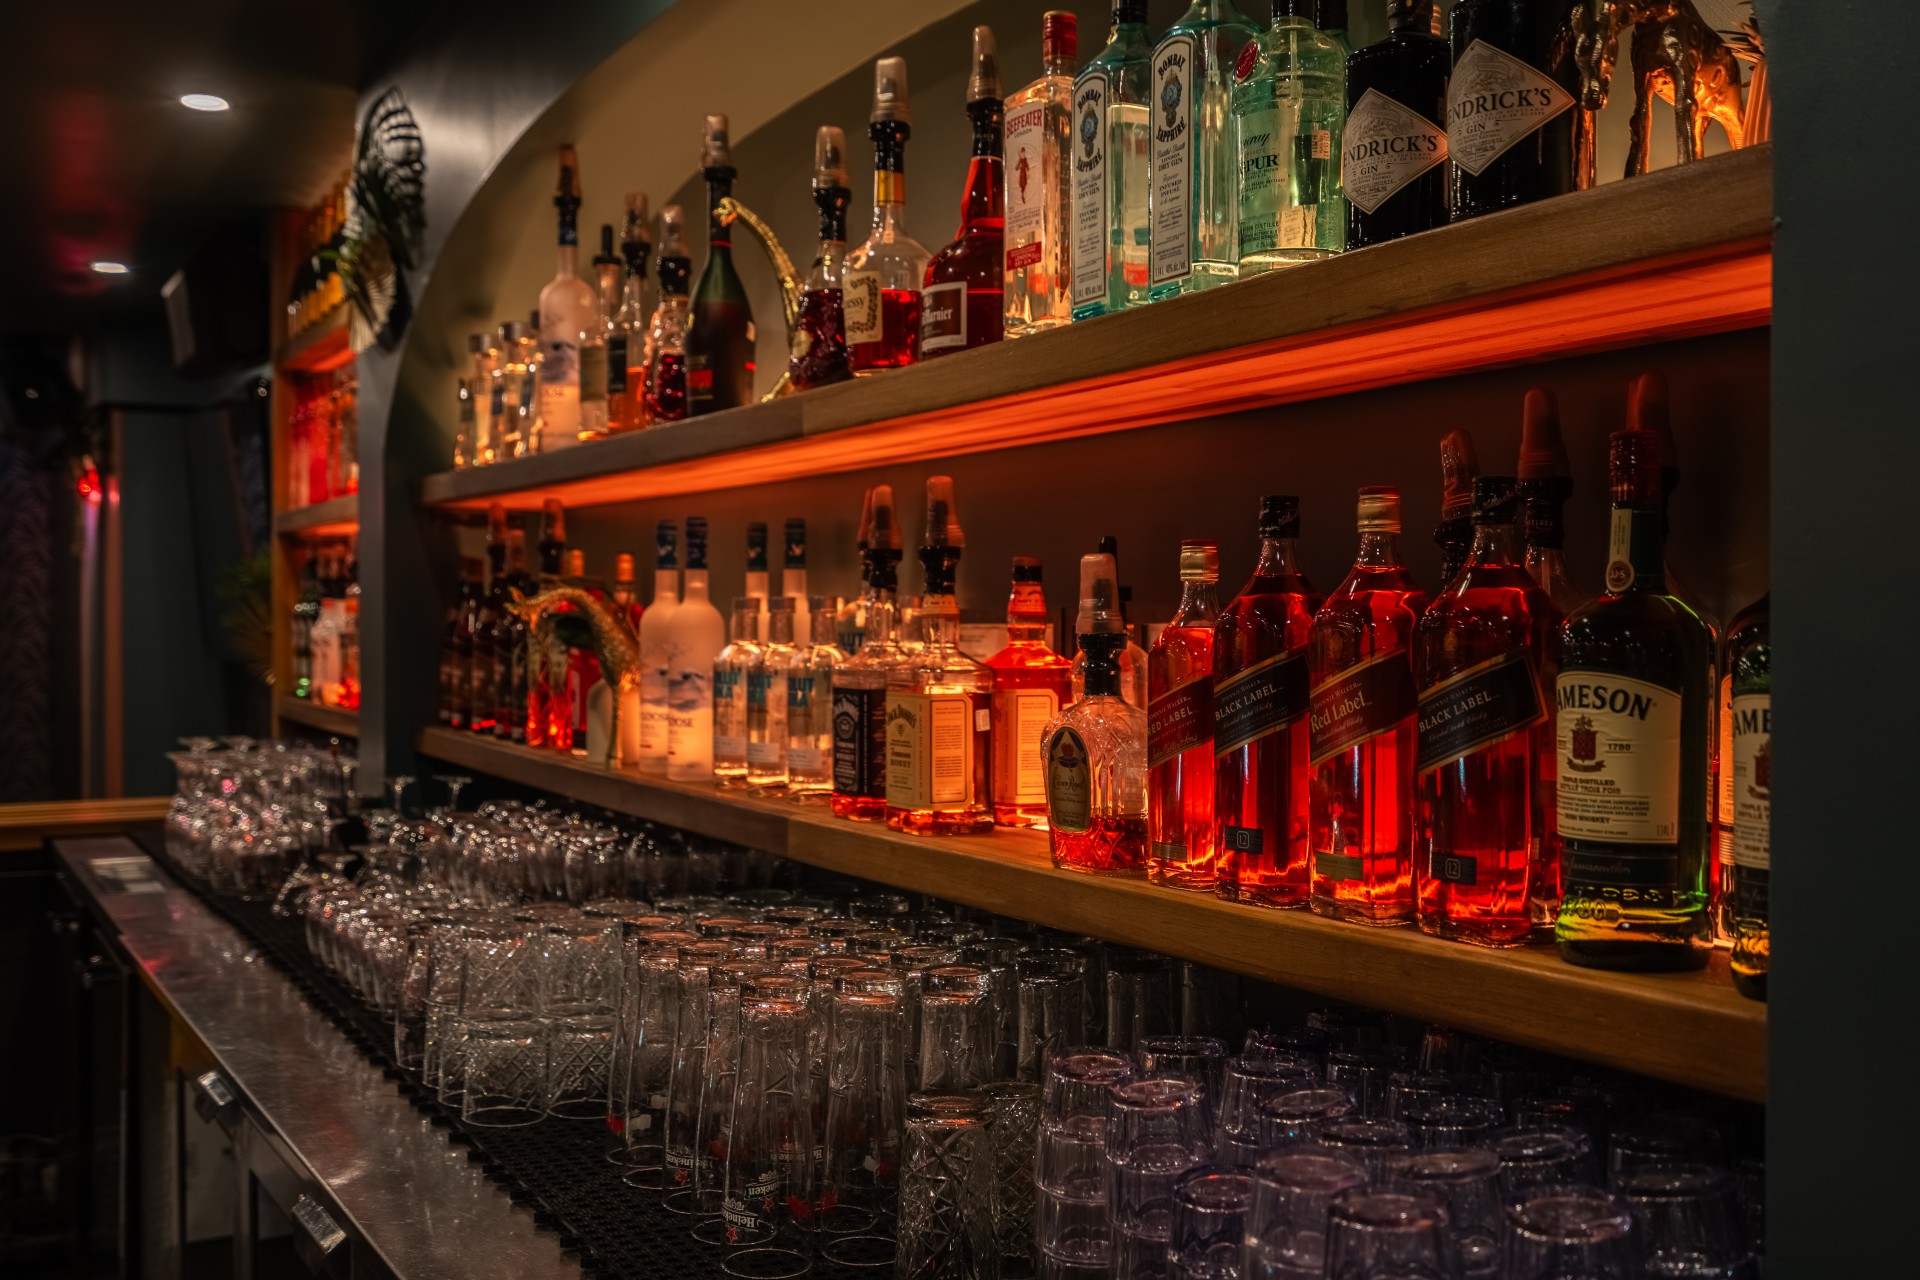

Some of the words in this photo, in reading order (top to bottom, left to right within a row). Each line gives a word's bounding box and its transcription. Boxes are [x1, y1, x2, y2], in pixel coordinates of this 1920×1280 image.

[1158, 53, 1186, 80] BOMBAY
[1077, 89, 1101, 114] BOMBAY
[1006, 108, 1043, 139] BEEFEATER
[1156, 115, 1187, 142] SAPPHIRE
[1466, 122, 1486, 134] GIN
[1076, 148, 1102, 172] SAPPHIRE
[1343, 134, 1438, 167] ENDRICK'S
[1158, 161, 1171, 172] DRY
[1171, 157, 1183, 167] GIN
[1244, 154, 1279, 173] PUR
[1360, 165, 1378, 176] GIN
[1215, 699, 1243, 721] BLACK
[1244, 684, 1277, 705] LABEL
[1310, 708, 1331, 733] Red
[1332, 690, 1367, 721] Label
[1419, 709, 1452, 733] BLACK
[1453, 691, 1492, 715] LABEL
[1558, 684, 1653, 721] AMESON
[1164, 705, 1193, 727] LABEL
[1607, 743, 1632, 751] 1780
[1579, 777, 1616, 787] DISTILLED
[1580, 785, 1601, 793] TROIS
[1579, 815, 1611, 824] WHISKEY
[1239, 834, 1248, 845] 12
[1448, 862, 1458, 875] 12
[721, 1207, 756, 1229] Heinek
